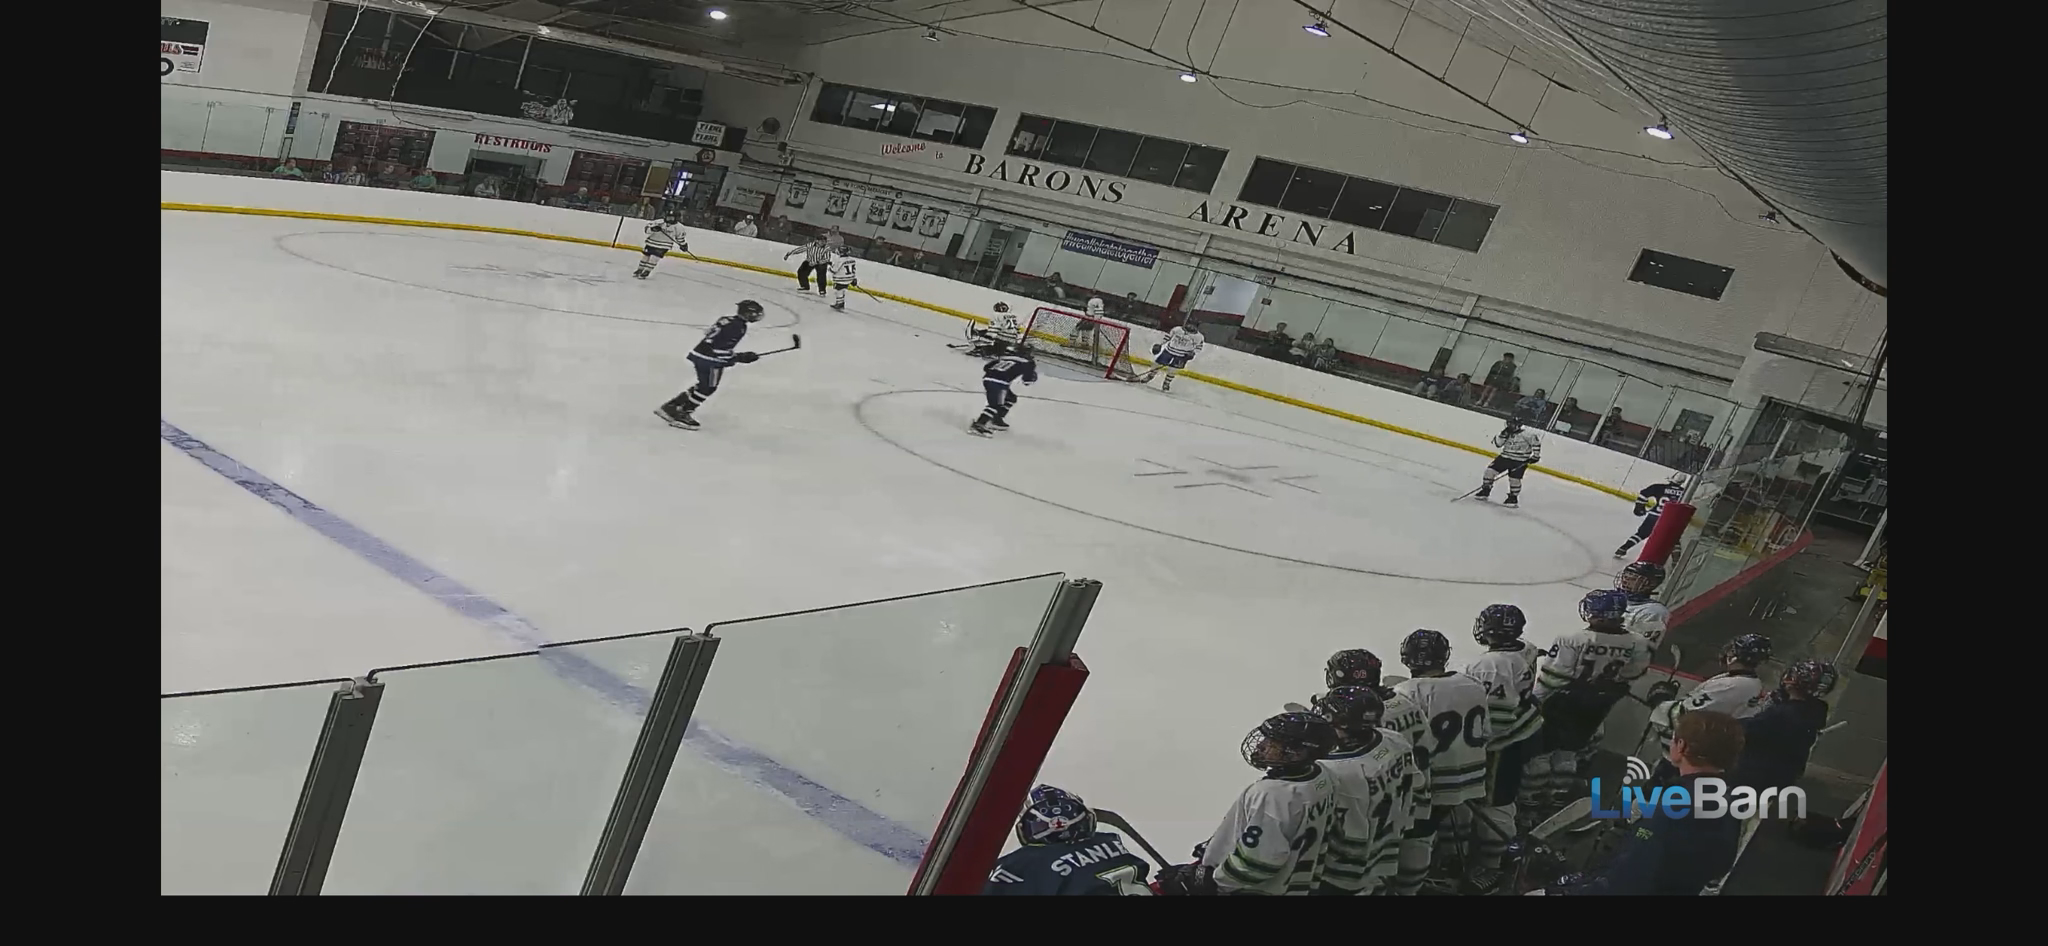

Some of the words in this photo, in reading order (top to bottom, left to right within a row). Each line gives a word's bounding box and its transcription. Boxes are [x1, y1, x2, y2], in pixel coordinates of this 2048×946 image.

[881, 142, 926, 155] Welcome
[935, 151, 944, 159] to
[963, 152, 1127, 203] BARONS
[1187, 200, 1361, 254] ARENA
[1548, 644, 1560, 658] 8
[1586, 644, 1634, 659] POTTS
[1429, 705, 1488, 759] 90
[1242, 825, 1263, 848] 8
